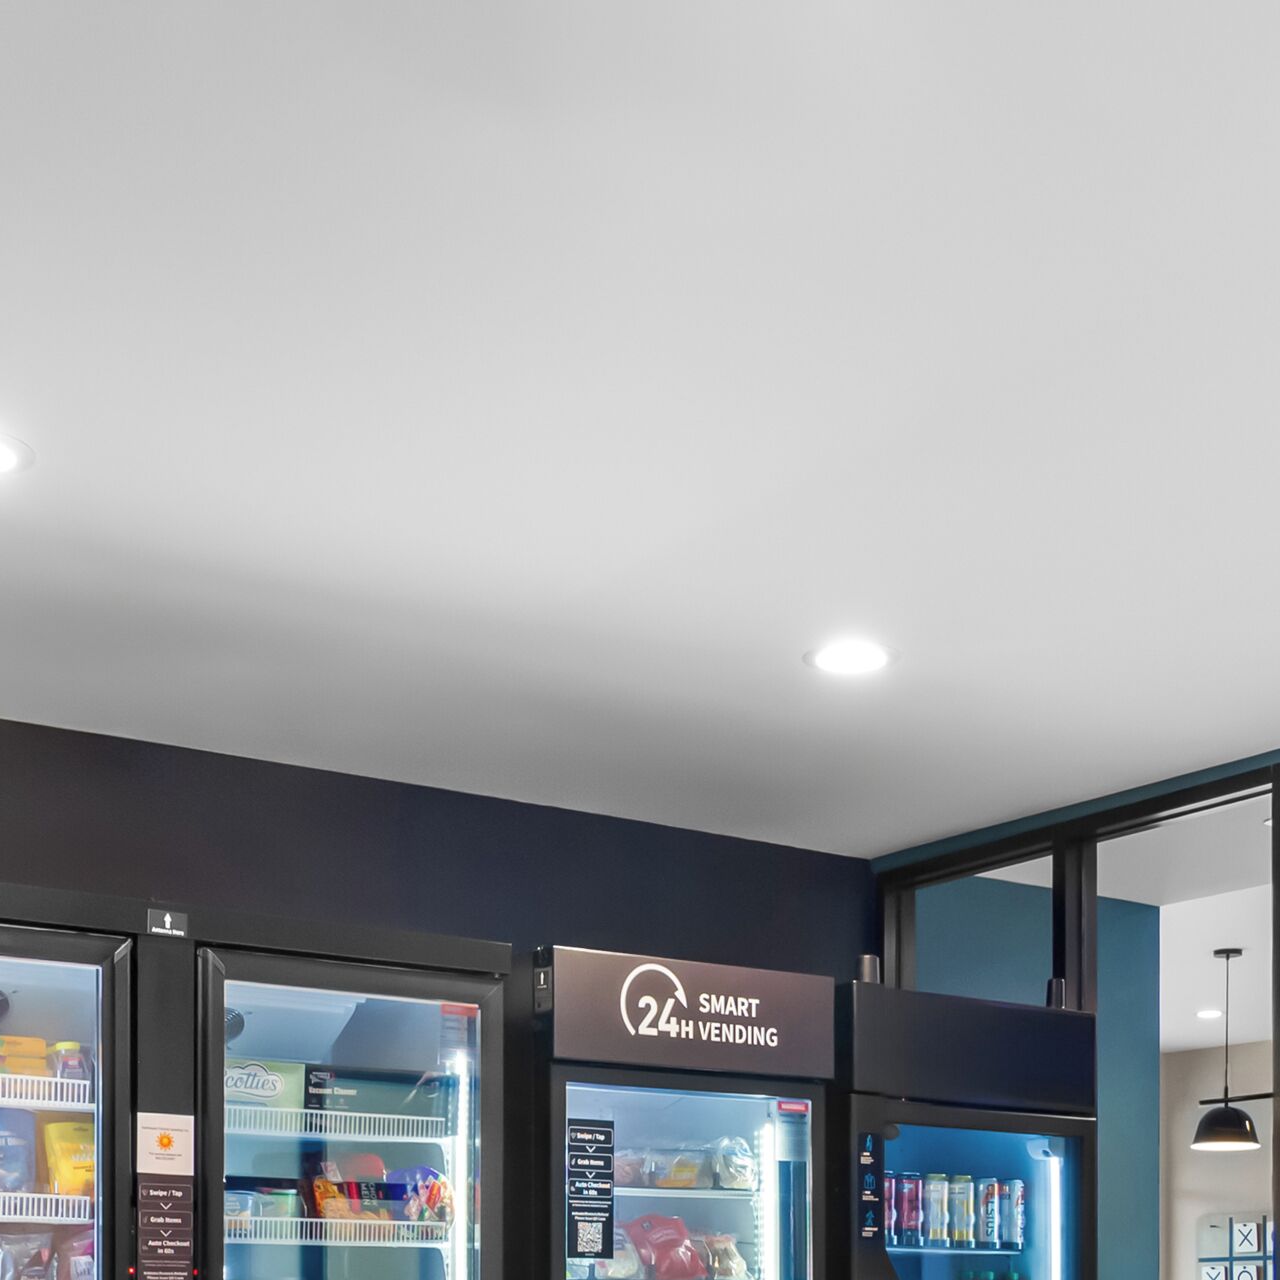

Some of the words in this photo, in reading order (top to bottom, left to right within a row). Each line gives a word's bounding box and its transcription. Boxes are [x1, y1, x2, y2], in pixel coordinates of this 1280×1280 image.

[699, 992, 760, 1018] SMART
[698, 1021, 779, 1047] VENDING
[224, 1071, 277, 1091] cotties
[172, 1190, 183, 1198] Tap
[361, 1183, 370, 1205] MEIN
